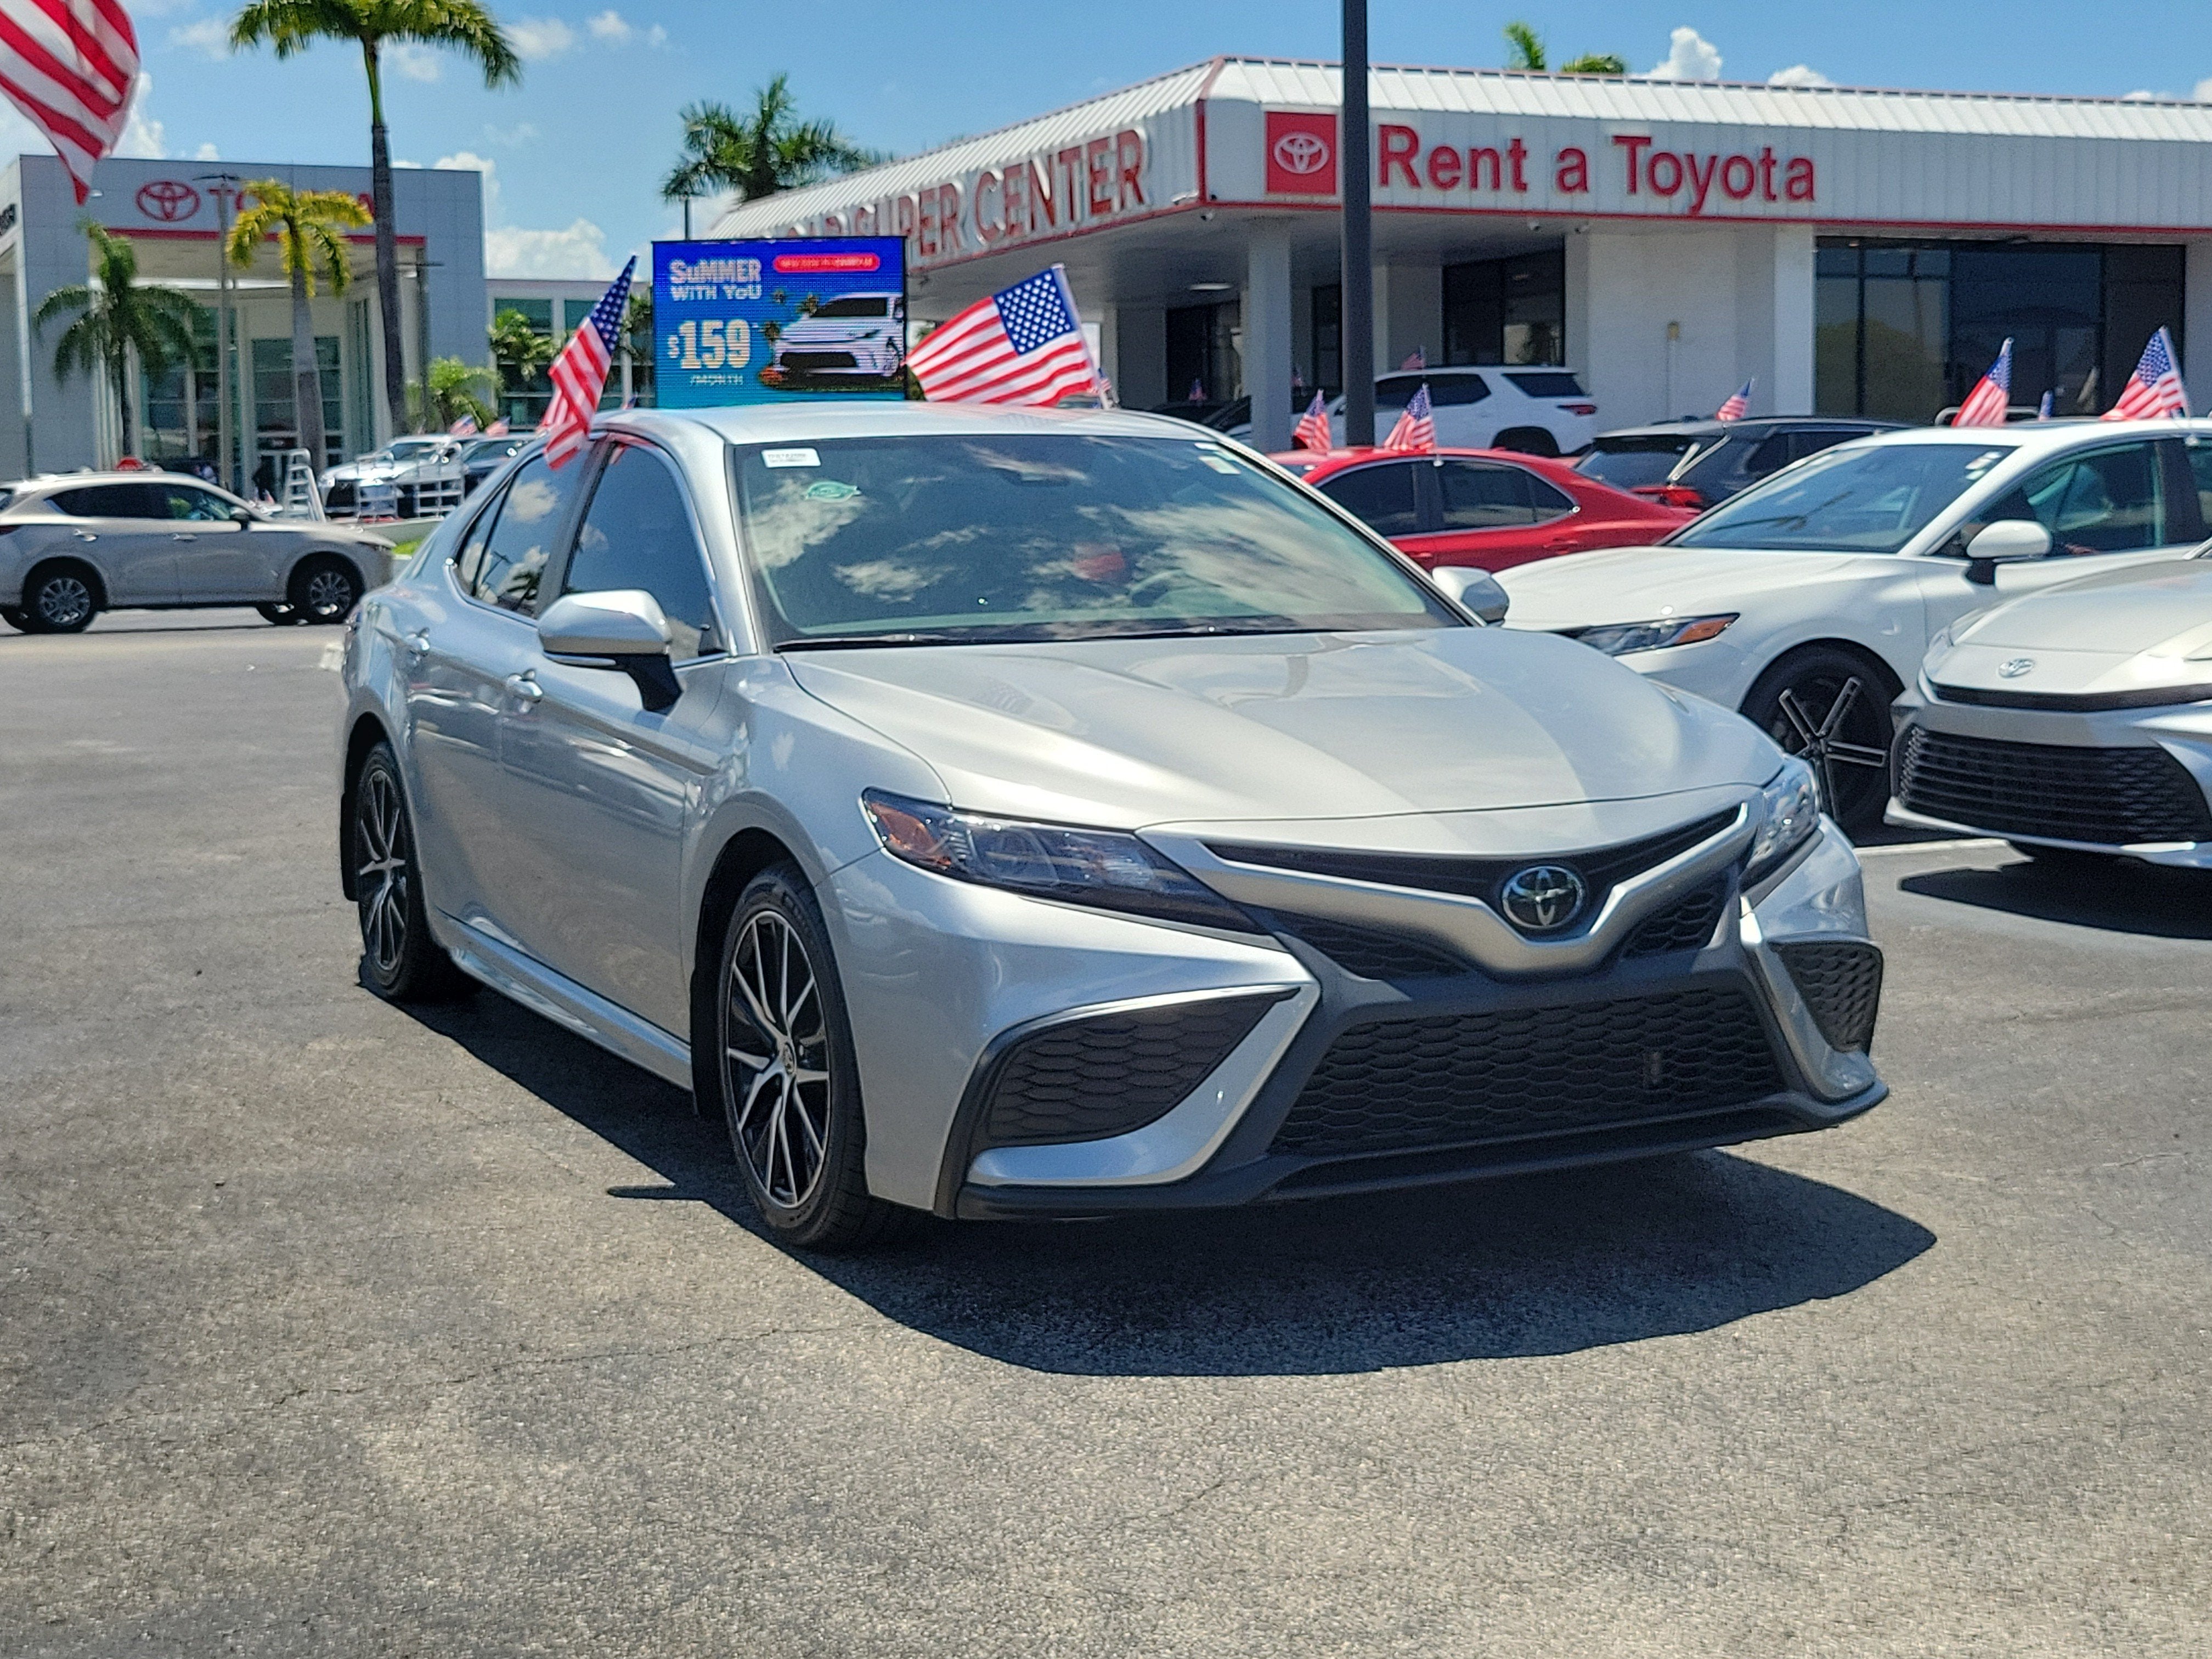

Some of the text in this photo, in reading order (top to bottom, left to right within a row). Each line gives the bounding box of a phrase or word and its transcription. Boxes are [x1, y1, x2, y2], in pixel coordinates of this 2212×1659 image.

[975, 129, 1146, 245] CENTER
[1378, 124, 1815, 216] Rent a Toyota
[670, 285, 717, 301] WITH
[667, 319, 750, 369] $159
